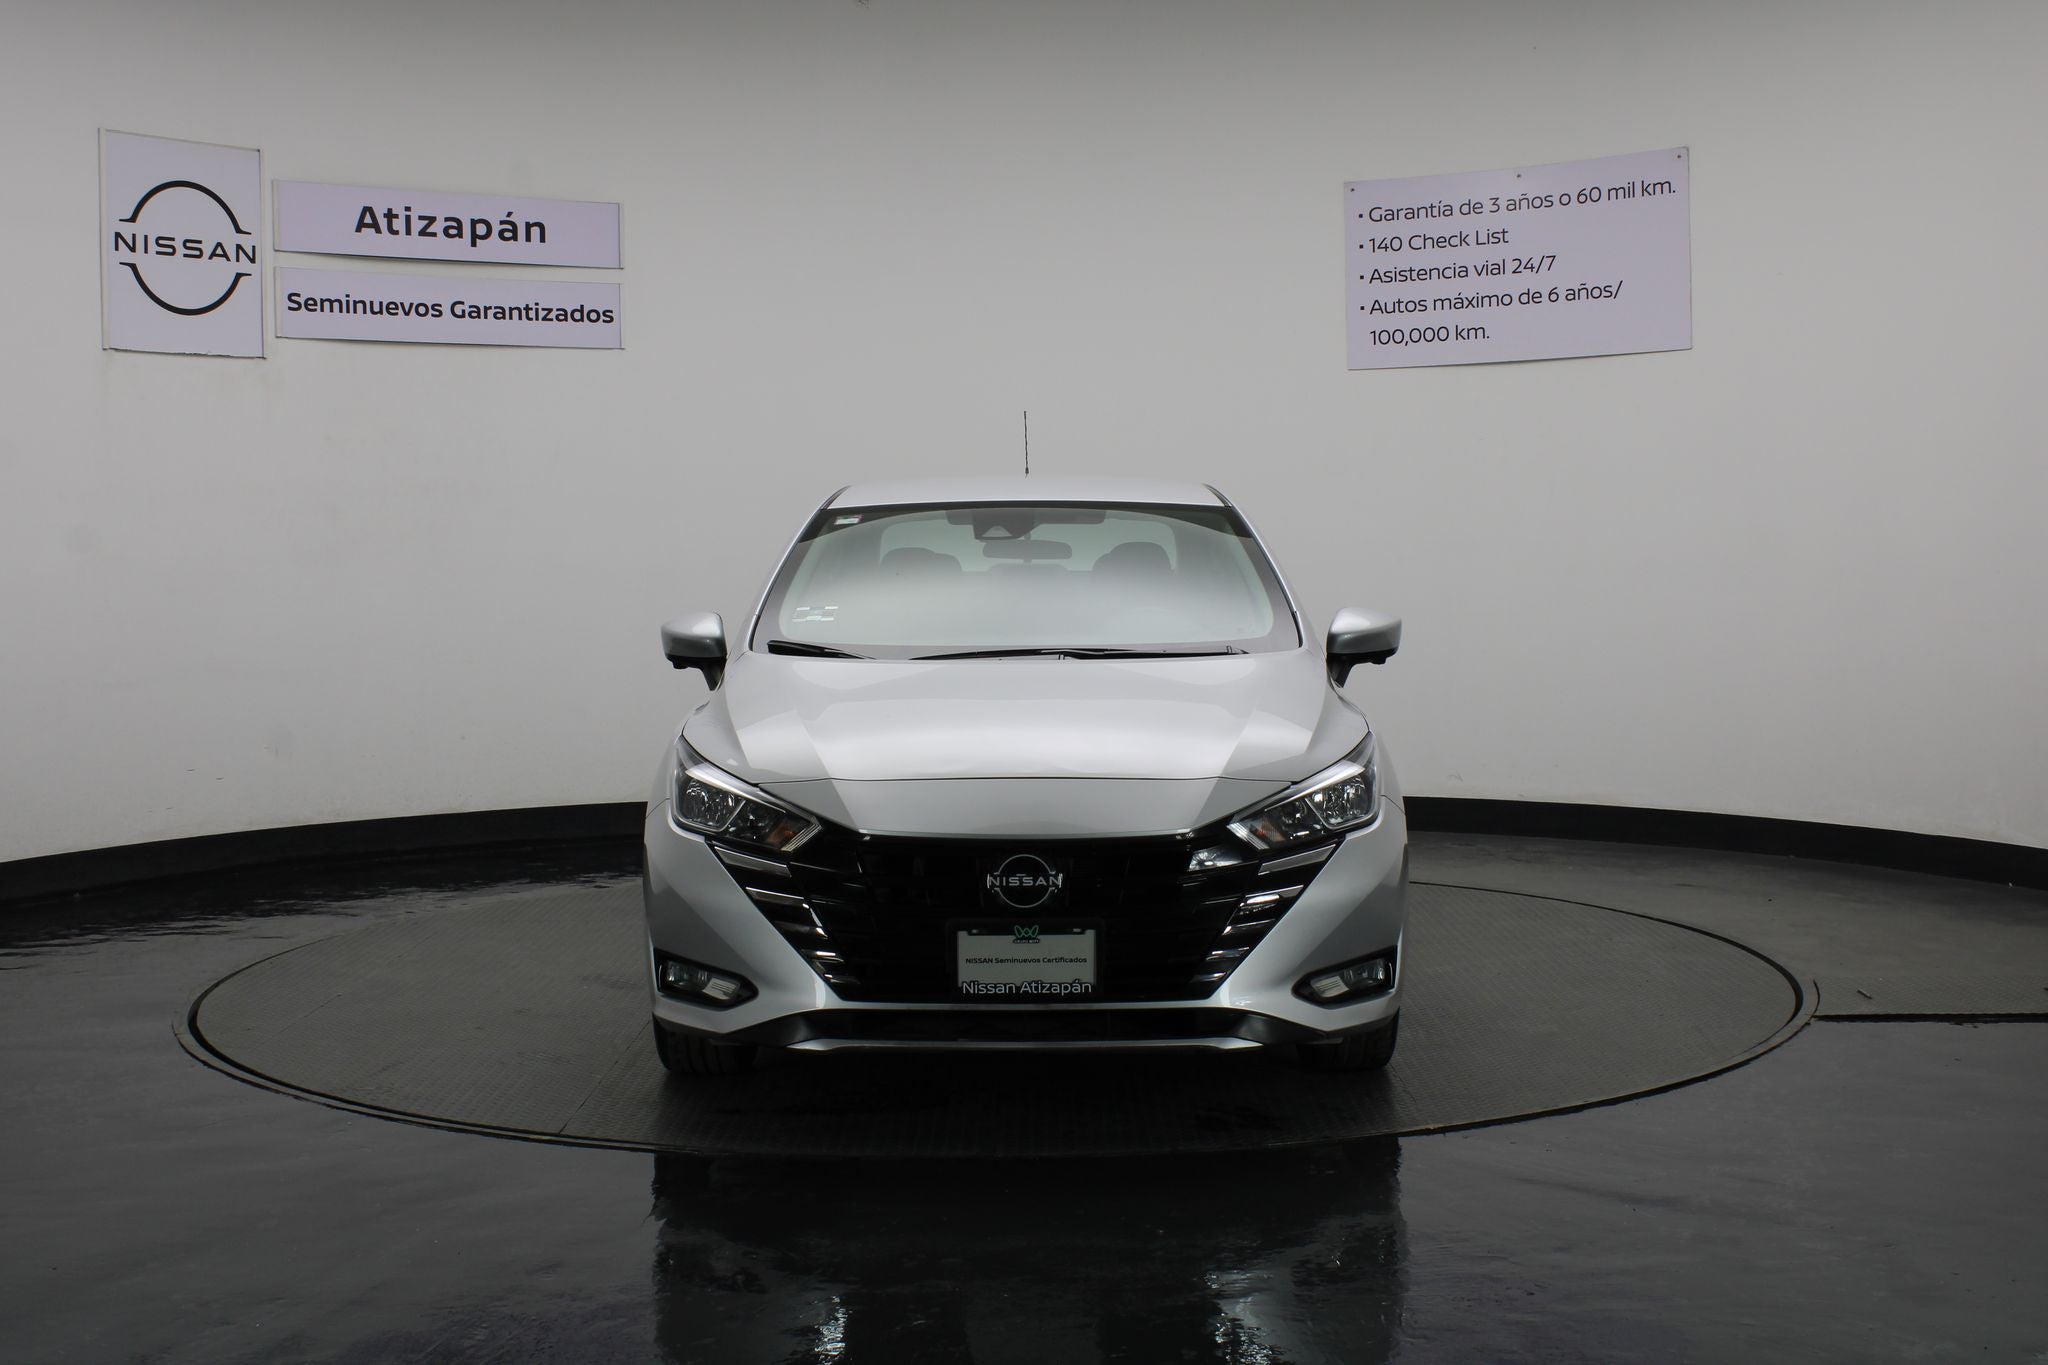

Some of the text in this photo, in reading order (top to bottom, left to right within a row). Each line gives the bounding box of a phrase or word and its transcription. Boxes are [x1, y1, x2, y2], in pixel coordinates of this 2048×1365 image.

[1368, 179, 1677, 223] Garantía de 3 años o 60 mil km.
[354, 204, 548, 248] Atizapán
[1368, 228, 1510, 254] 140 Check List
[114, 231, 257, 265] NISSAN
[1368, 255, 1557, 285] Asistencia vial 24/7
[286, 291, 616, 326] Seminuevos Garantizados
[1369, 280, 1624, 316] Autos máximo de 6 años/
[1369, 323, 1491, 347] 100,000 km.
[988, 876, 1061, 887] NISSAN
[1042, 956, 1088, 964] Certificados
[962, 979, 1092, 996] Nissan Atizapán
